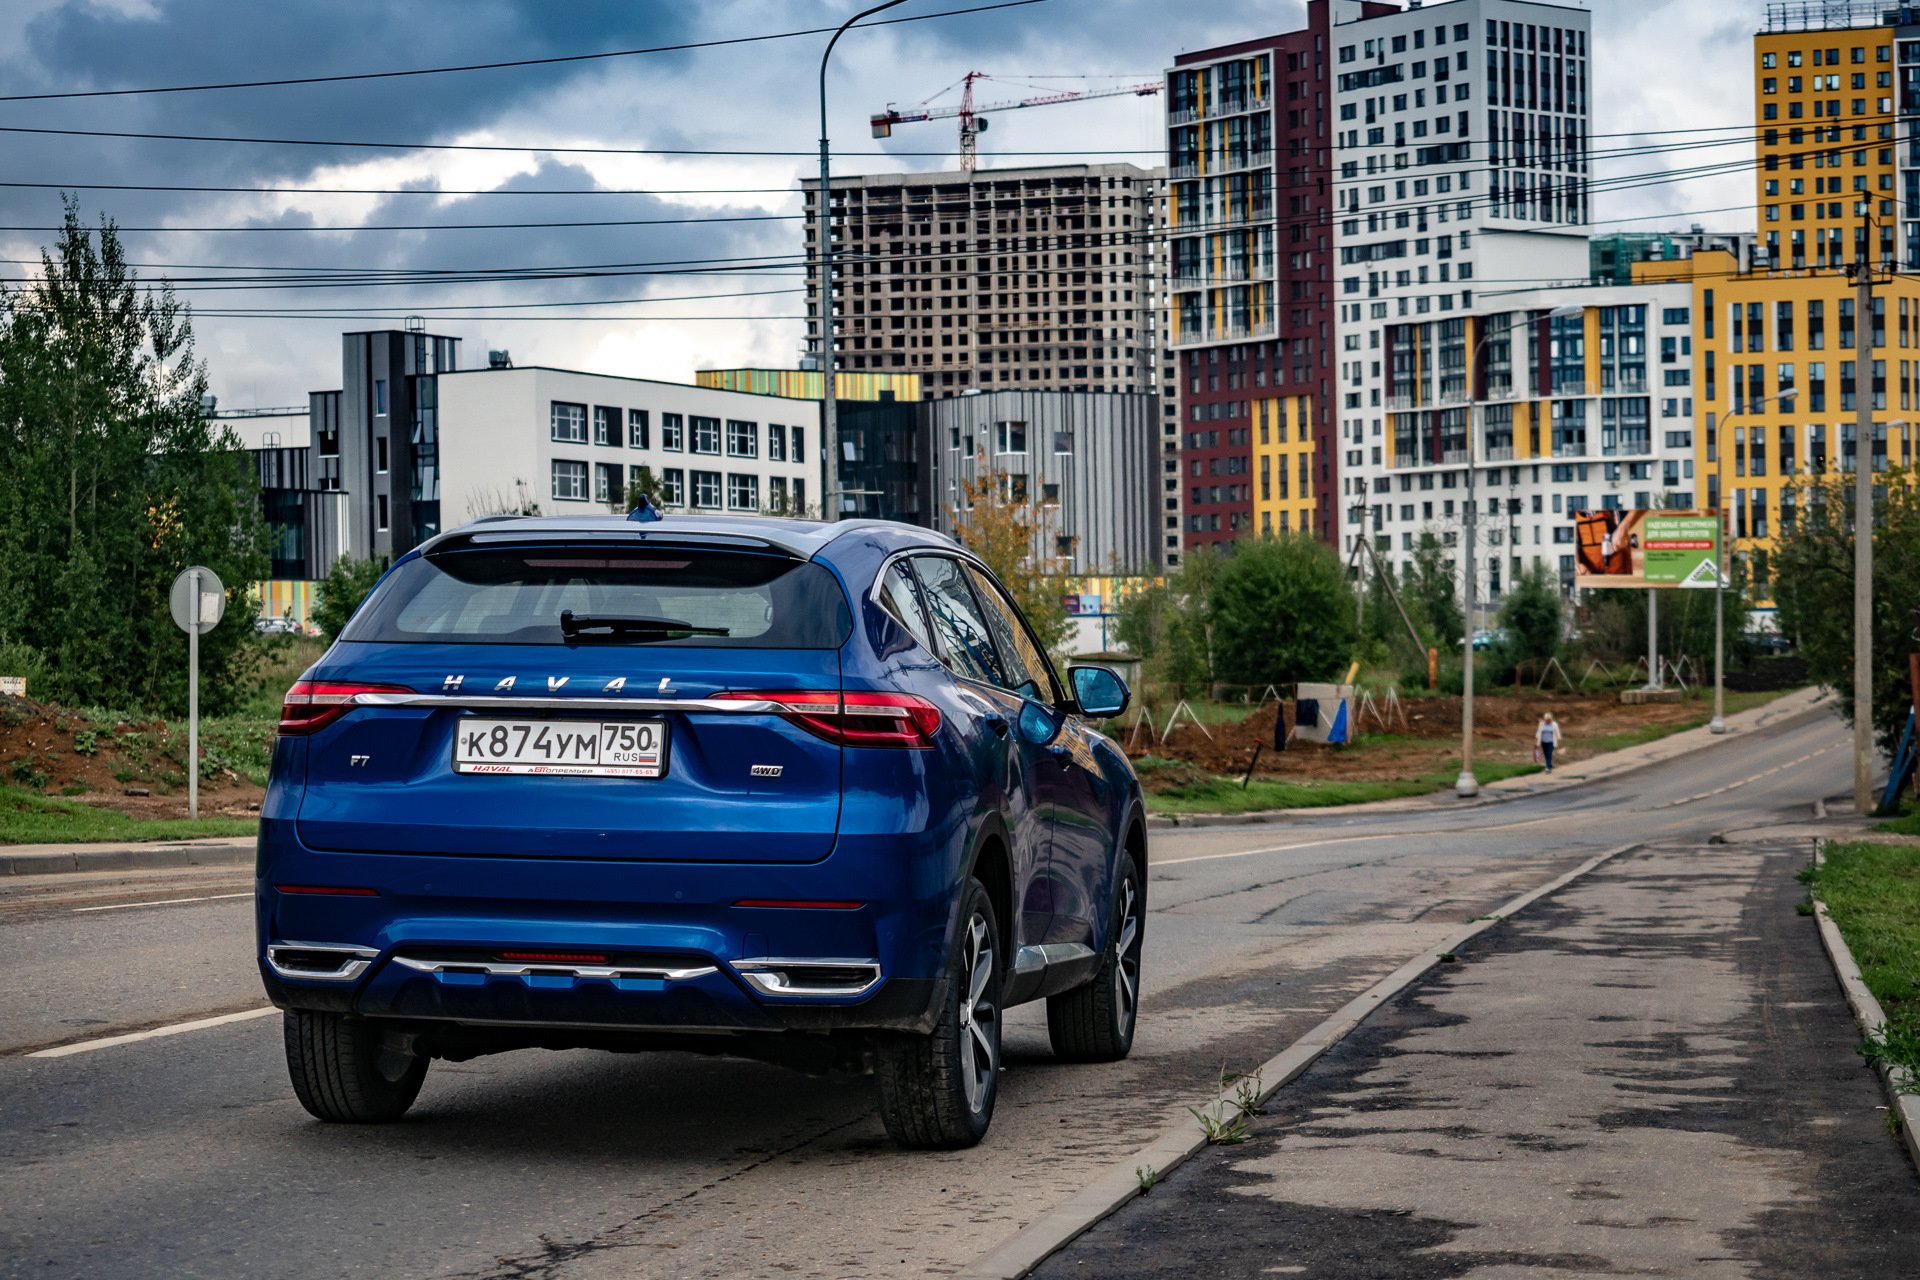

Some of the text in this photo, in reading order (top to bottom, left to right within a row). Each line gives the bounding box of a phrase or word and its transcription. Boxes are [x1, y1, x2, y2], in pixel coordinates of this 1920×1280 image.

[1680, 520, 1717, 529] ИНСТРУМЕНТ
[442, 674, 677, 693] HAVAL
[603, 725, 653, 751] 750
[350, 755, 370, 766] F7
[613, 752, 638, 762] RUS
[472, 765, 513, 773] HAVAL
[752, 766, 780, 776] 4WD
